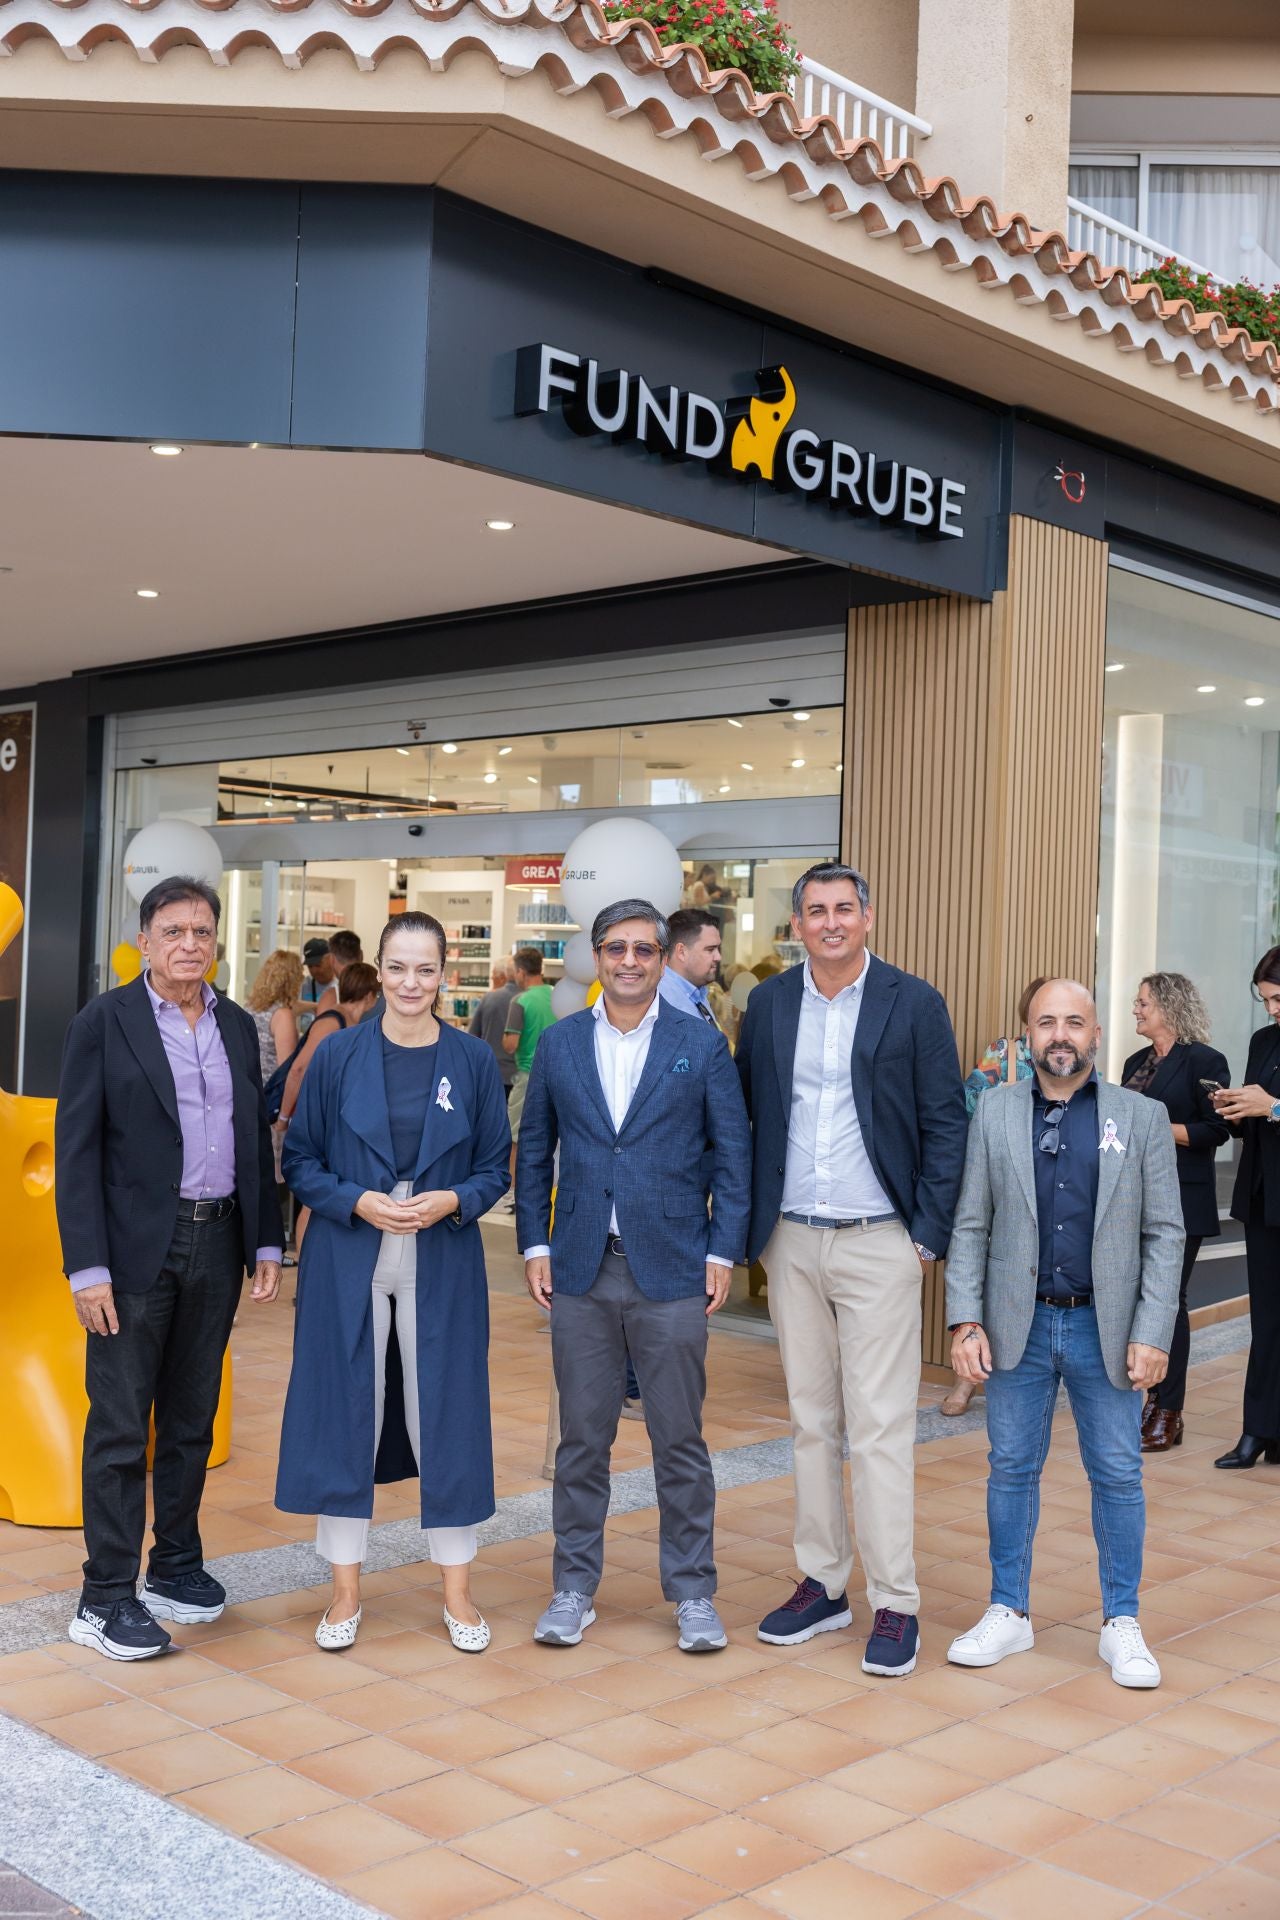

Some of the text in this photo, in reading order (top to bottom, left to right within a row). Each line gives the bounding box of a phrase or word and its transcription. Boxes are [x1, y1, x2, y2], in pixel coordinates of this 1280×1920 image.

[539, 343, 967, 539] FUND GRUBE
[521, 865, 561, 879] GREAT
[565, 870, 598, 880] GRUBE
[81, 1607, 107, 1632] HOKA
